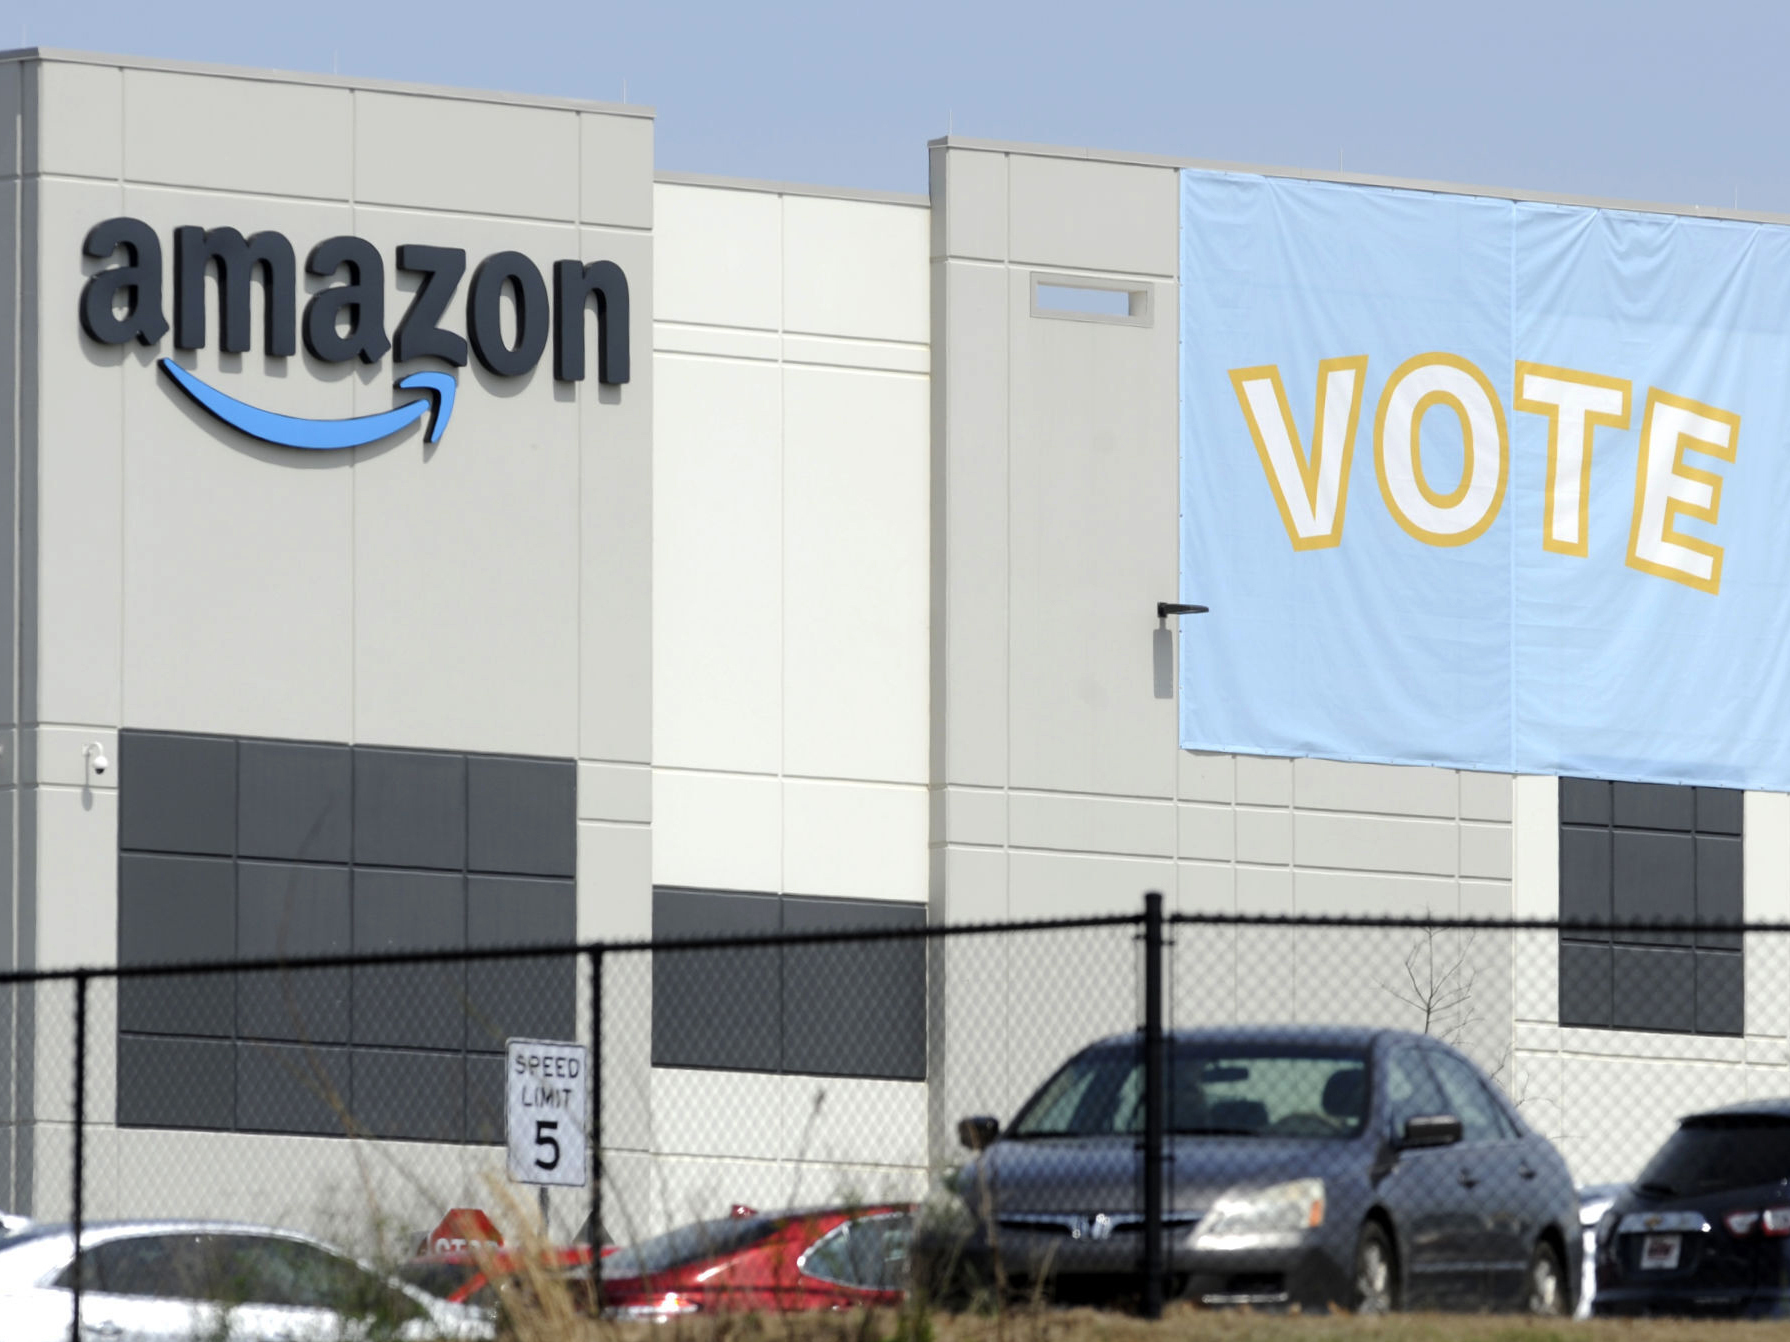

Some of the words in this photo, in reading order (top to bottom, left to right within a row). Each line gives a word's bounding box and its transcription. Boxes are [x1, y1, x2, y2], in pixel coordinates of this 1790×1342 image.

[79, 216, 630, 384] amazon
[1227, 351, 1741, 596] VOTE
[514, 1054, 580, 1079] SPEED
[522, 1085, 573, 1109] LIMIT
[534, 1119, 561, 1171] 5
[435, 1237, 498, 1255] ST
